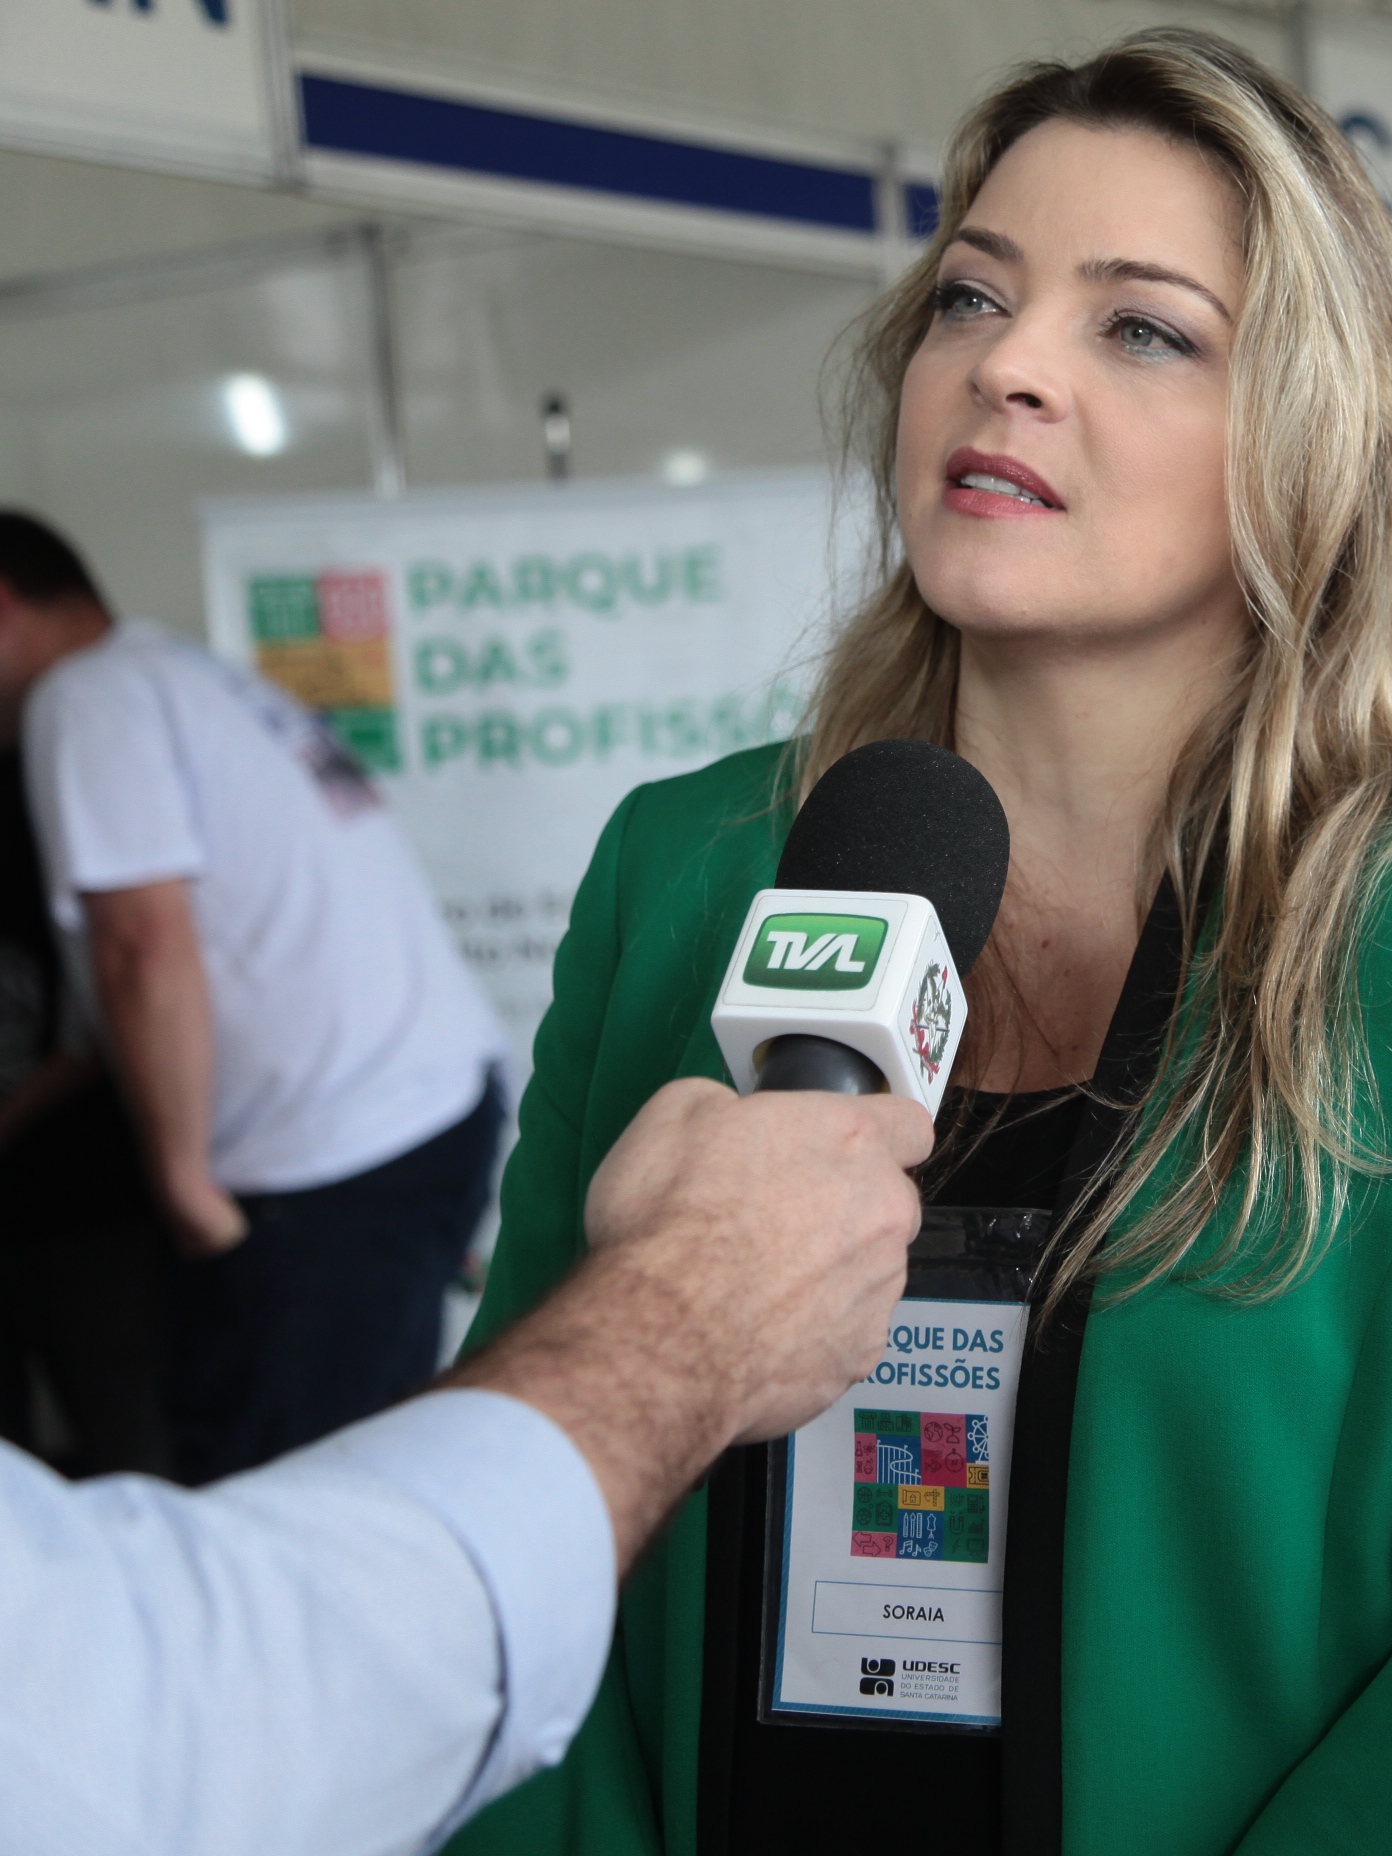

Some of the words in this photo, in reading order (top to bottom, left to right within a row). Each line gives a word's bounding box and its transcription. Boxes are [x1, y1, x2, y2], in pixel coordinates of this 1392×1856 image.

[408, 546, 724, 616] PARQUE
[415, 630, 570, 694] DAS
[952, 1328, 1004, 1353] DAS
[882, 1604, 945, 1622] SORAIA
[902, 1660, 961, 1674] UDESC
[900, 1682, 912, 1690] DO
[914, 1683, 945, 1691] ESTADO
[901, 1674, 960, 1683] UNIVERSIDADE
[900, 1691, 923, 1699] SANTA
[924, 1692, 958, 1701] CATARINA
